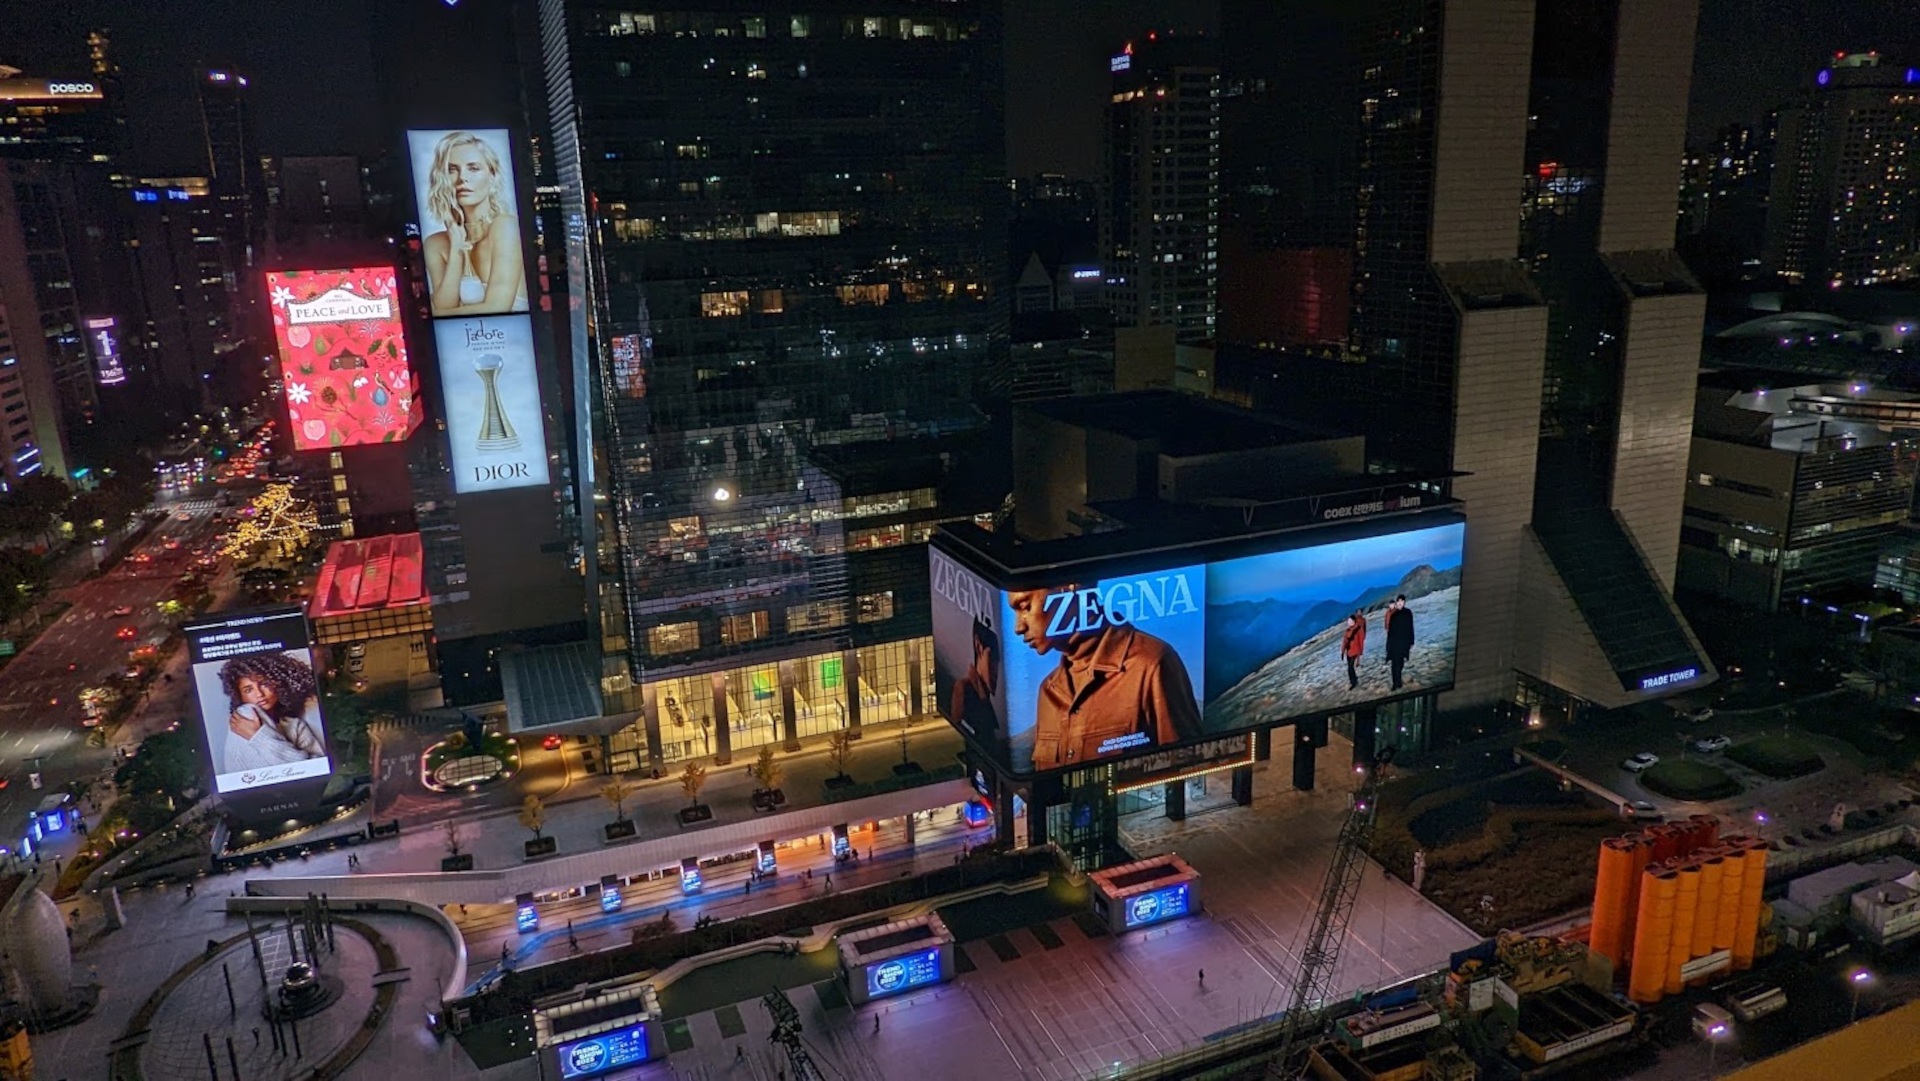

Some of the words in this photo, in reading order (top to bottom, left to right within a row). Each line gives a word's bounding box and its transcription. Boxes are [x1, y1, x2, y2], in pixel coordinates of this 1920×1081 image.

[49, 83, 94, 95] posco
[295, 306, 337, 318] PEACE
[338, 307, 350, 315] and
[351, 304, 384, 315] LOVE
[473, 462, 531, 482] DIOR
[1324, 506, 1352, 519] coex
[932, 553, 998, 635] ZEGNA
[1043, 573, 1199, 637] ZEGNA
[1642, 674, 1669, 689] TRADE
[1669, 669, 1695, 683] TOWER
[260, 802, 299, 814] PARNAS
[572, 1044, 600, 1056] TREND
[579, 1049, 603, 1060] SHOW
